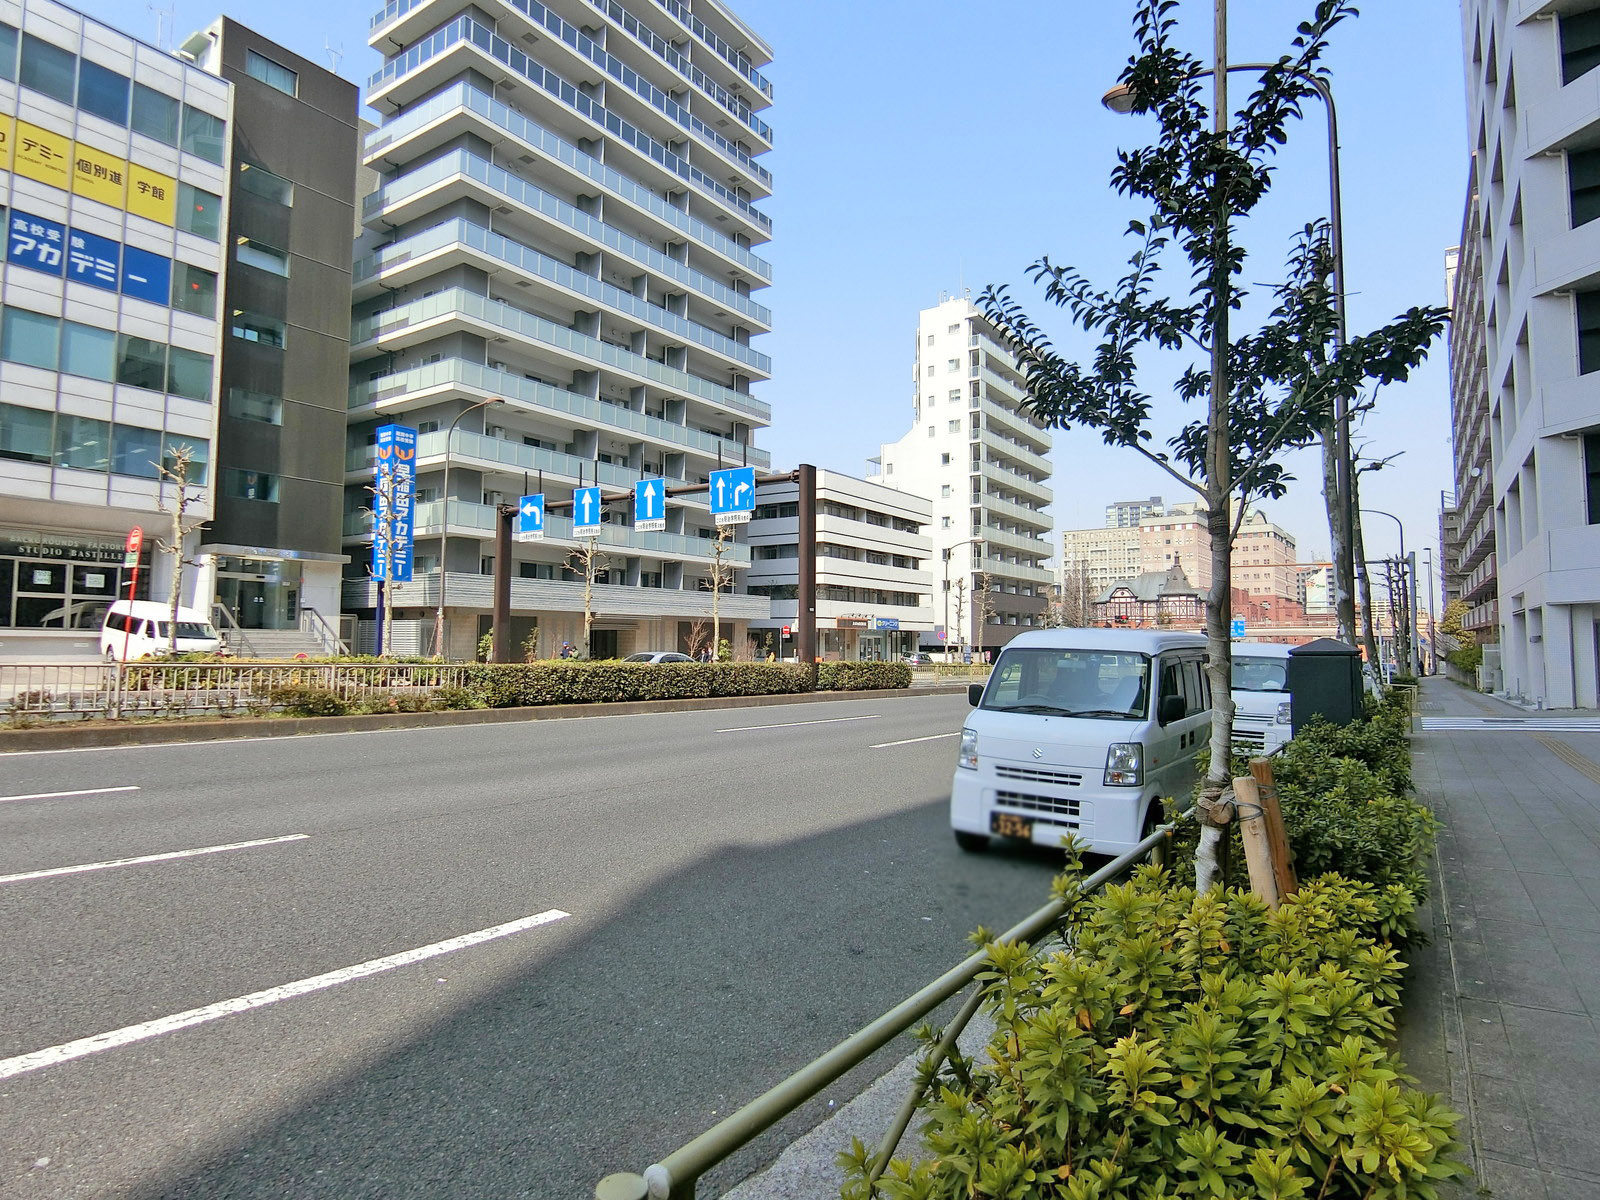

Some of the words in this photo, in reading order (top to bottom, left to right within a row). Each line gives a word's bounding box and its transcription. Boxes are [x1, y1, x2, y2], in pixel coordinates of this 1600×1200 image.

[13, 218, 85, 250] 高校受験
[11, 233, 147, 283] アカデミー
